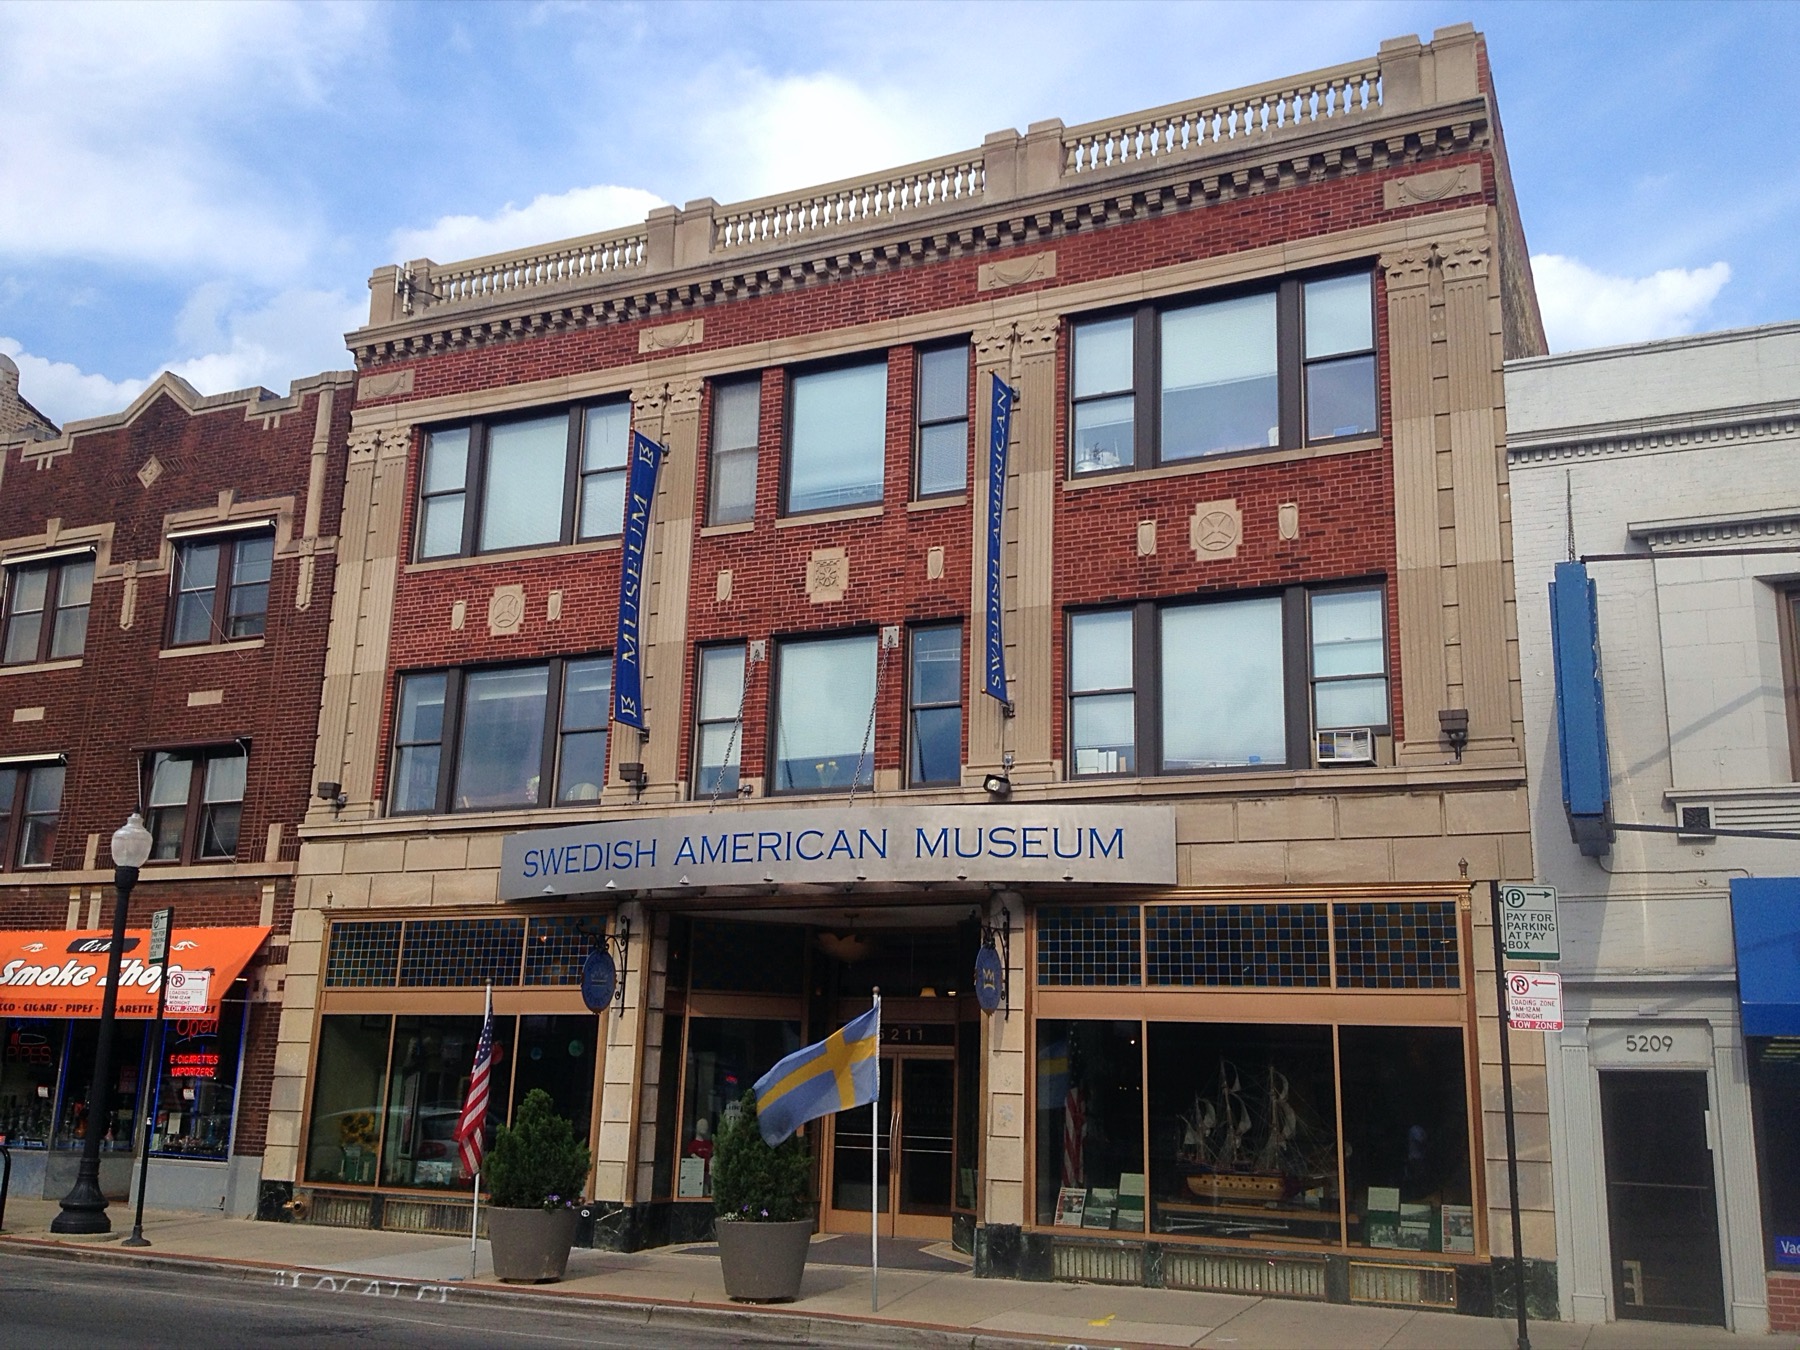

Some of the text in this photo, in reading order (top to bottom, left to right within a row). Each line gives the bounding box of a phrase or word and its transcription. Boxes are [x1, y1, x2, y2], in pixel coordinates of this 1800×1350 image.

[991, 387, 1008, 689] SWEDISH AMERICAN
[621, 491, 648, 667] MUSEUM
[523, 826, 1124, 878] SWEDISH AMERICAN MUSEUM
[1506, 912, 1552, 922] PAY FOR
[1506, 922, 1555, 932] PARKING
[1508, 931, 1546, 941] AT PAY
[1508, 940, 1531, 950] BOX
[0, 958, 98, 988] Smoke
[23, 1003, 58, 1013] CIGARS
[65, 1003, 94, 1013] PIPES
[1511, 998, 1556, 1008] LOADING ZONE
[1515, 1012, 1544, 1020] MIDNIGHT
[176, 1018, 220, 1042] Open
[1513, 1020, 1559, 1030] TOW ZONE
[1626, 1034, 1673, 1053] 5209
[169, 1054, 219, 1066] E-CIGARETTES
[170, 1066, 214, 1078] VAPORIZERS
